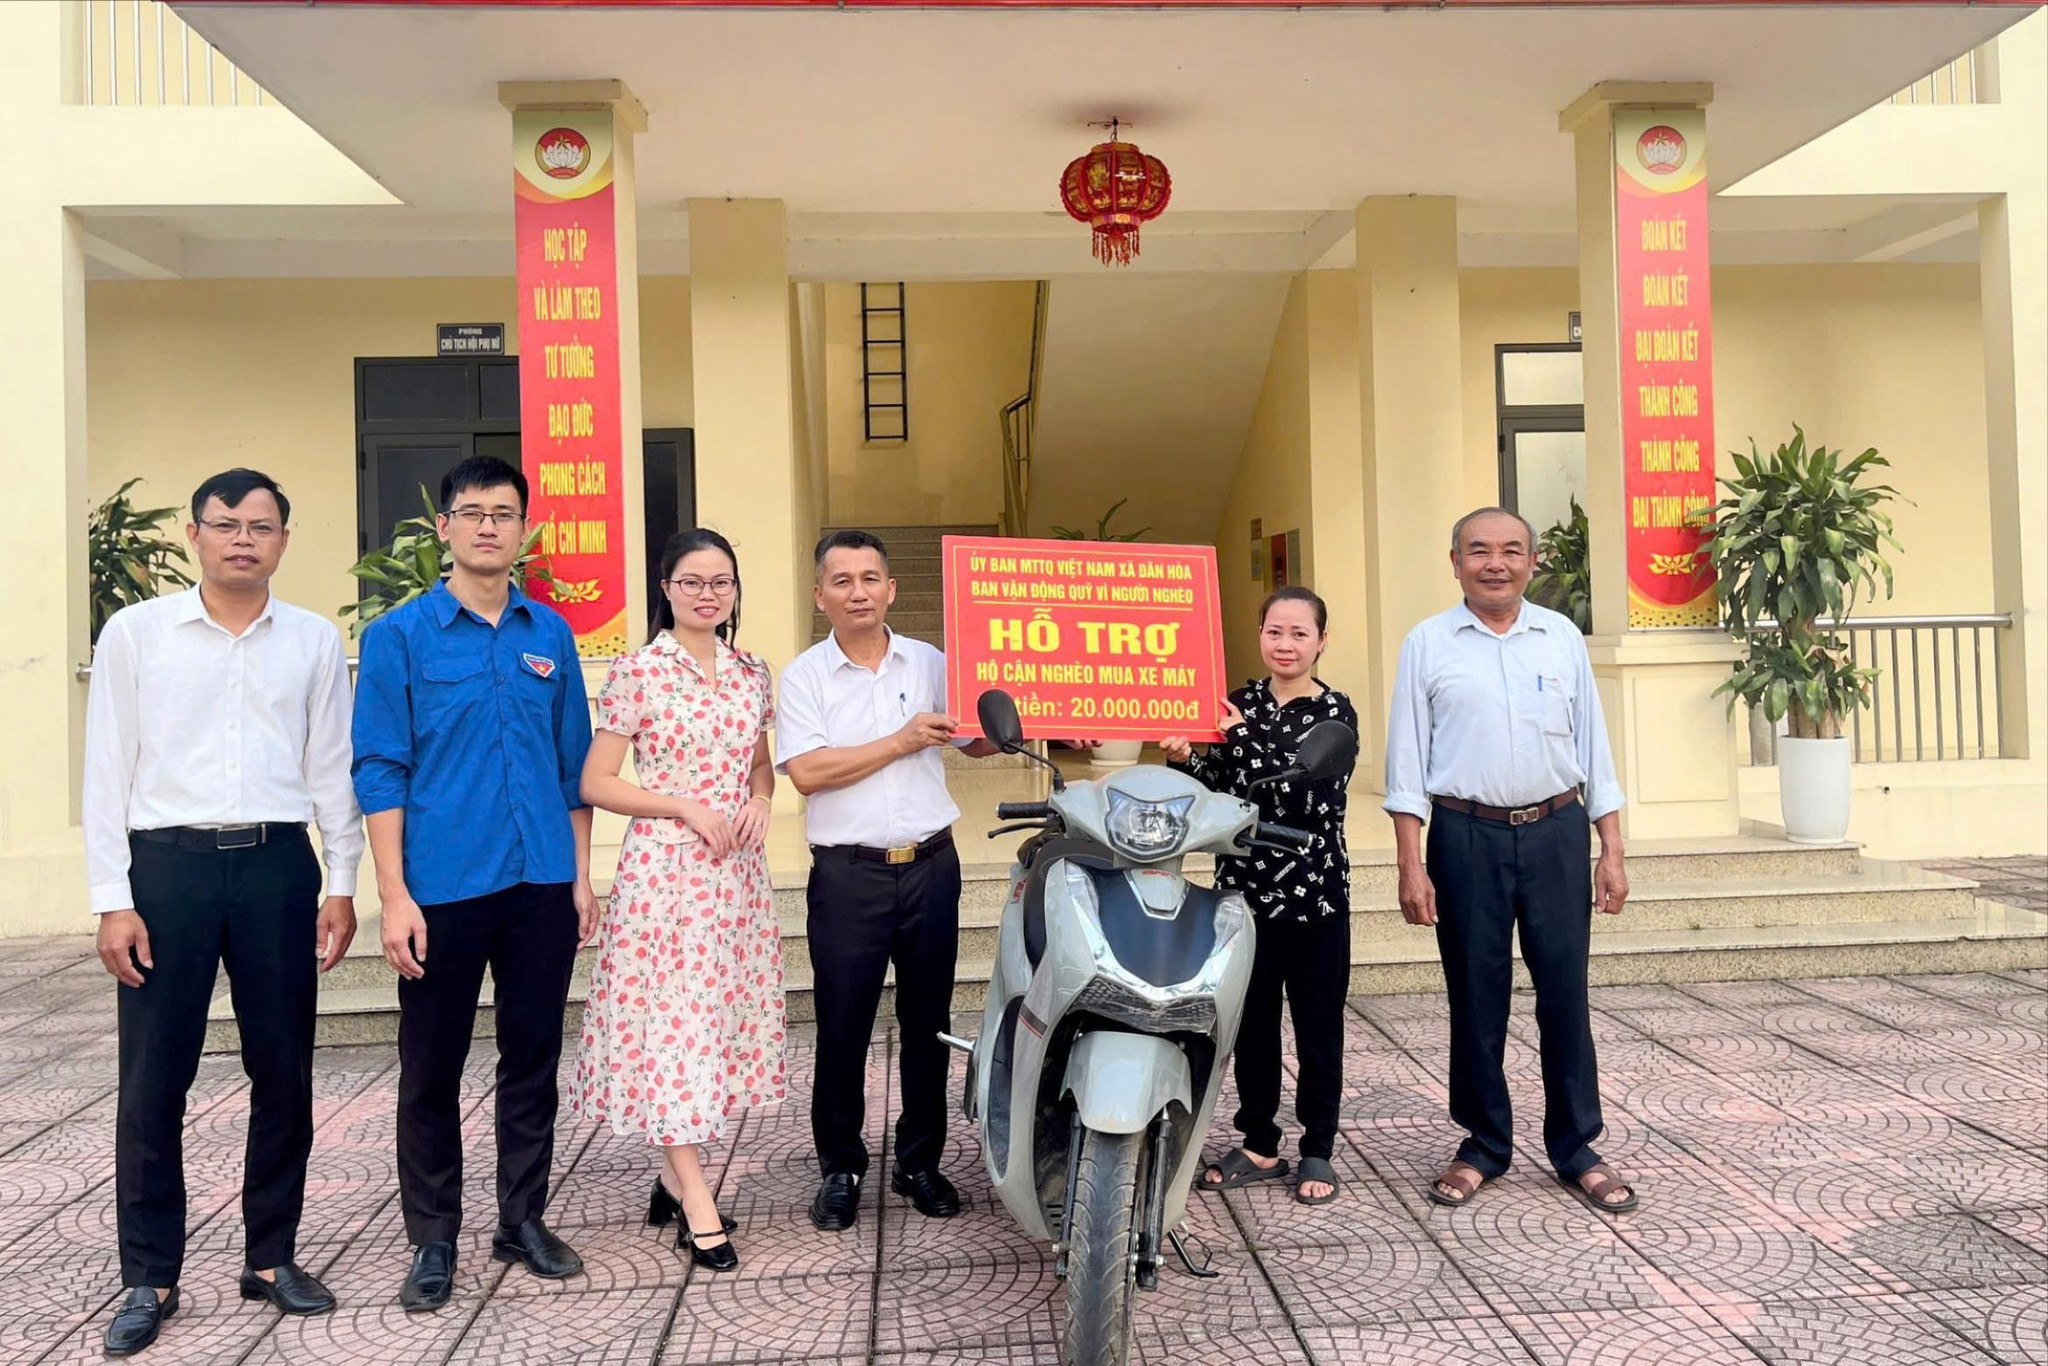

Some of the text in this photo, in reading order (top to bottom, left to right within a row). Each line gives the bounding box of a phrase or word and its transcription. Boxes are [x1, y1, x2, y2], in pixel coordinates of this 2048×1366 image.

[544, 221, 587, 269] HỌC TẬP
[1641, 210, 1687, 251] ĐOÀN KẾT
[534, 280, 601, 320] VÀ LÀM THEO
[1643, 265, 1688, 306] ĐOÀN KẾT
[544, 335, 594, 379] TƯ TƯỞNG
[1636, 320, 1699, 368] ĐẠI ĐOÀN KẾT
[1639, 379, 1698, 417] THÀNH CÔNG
[548, 397, 593, 445] ĐẠO ĐỨC
[1640, 434, 1699, 472] THÀNH CÔNG
[540, 454, 606, 496] PHONG CÁCH
[1633, 496, 1648, 535] ĐẠI
[1651, 489, 1682, 528] THÀNH
[559, 513, 576, 555] CHÍ
[579, 520, 607, 555] MINH
[970, 550, 986, 571] ỦY
[990, 557, 1016, 573] BAN
[1020, 558, 1054, 576] MTTQ
[1057, 557, 1082, 579] VIỆT
[1087, 560, 1115, 577] NAM
[1119, 560, 1135, 578] XÃ
[1167, 561, 1192, 580] HÒA
[972, 579, 1194, 604] BAN VẬN ĐỘNG QUỸ VÌ NGƯỜI NGHÈO
[989, 607, 1180, 663] HỖ TRỢ
[976, 659, 1196, 687] HỘ CẬN NGHÈO MUA XE MÁY
[1014, 691, 1199, 720] tiền: 20.000.000đ
